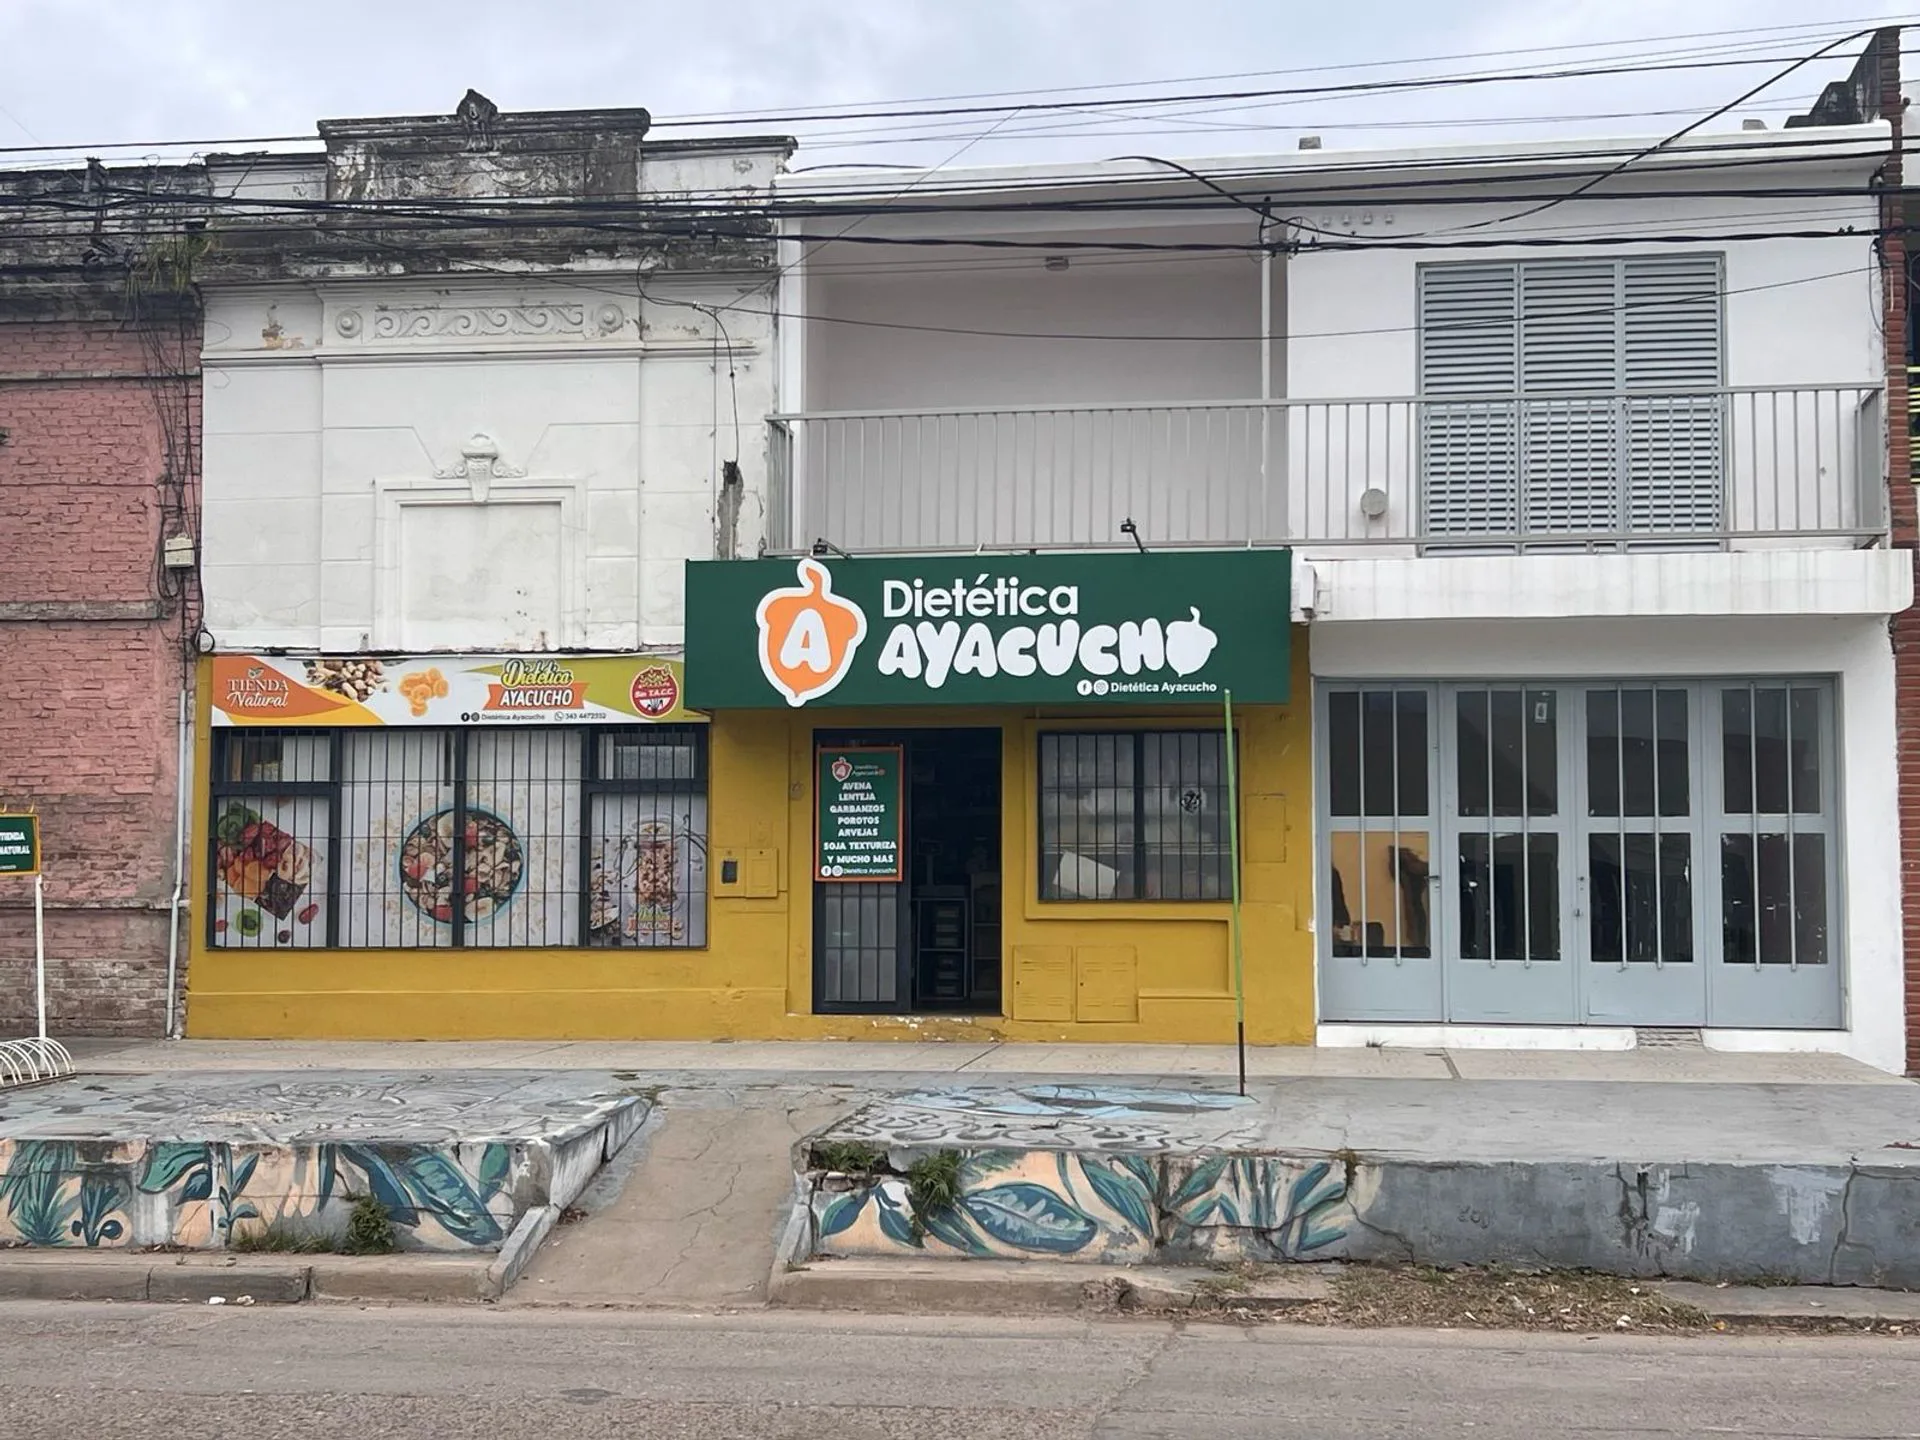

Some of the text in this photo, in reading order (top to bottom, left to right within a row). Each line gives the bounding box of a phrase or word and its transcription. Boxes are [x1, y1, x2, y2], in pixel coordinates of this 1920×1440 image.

[883, 574, 1079, 616] Dietética
[780, 609, 831, 673] A
[878, 606, 1218, 688] AYACUCHO
[227, 679, 288, 691] TIENDA
[1110, 681, 1217, 694] Dietética Ayacucho
[227, 690, 288, 708] Natural
[500, 689, 573, 706] AYACUCHO
[842, 782, 872, 790] AVENA
[838, 793, 876, 801] LENTEJA
[829, 805, 885, 813] GARBANZOS
[837, 816, 880, 825] POROTOS
[838, 828, 878, 837] ARVEJAS
[823, 841, 897, 850] SOJA TEXTURIZA
[827, 854, 894, 863] Y MUCHO MAS
